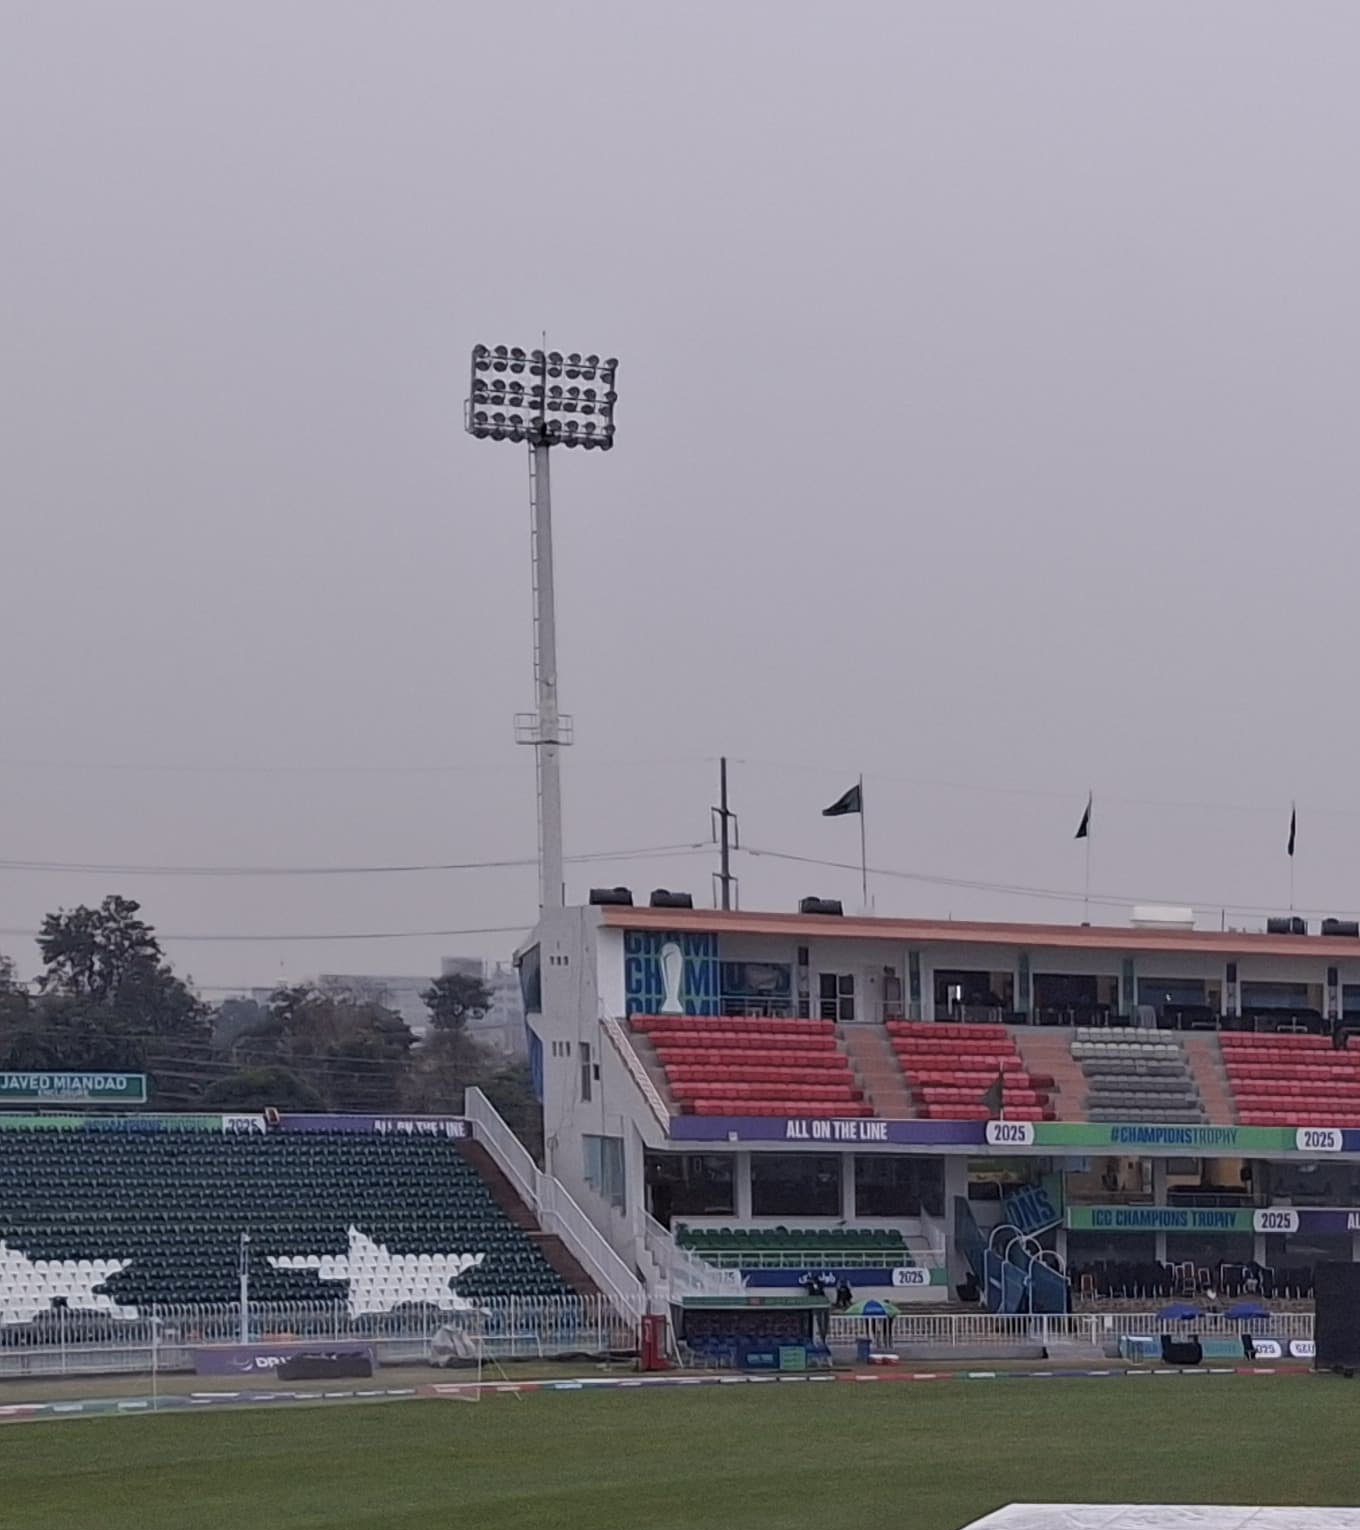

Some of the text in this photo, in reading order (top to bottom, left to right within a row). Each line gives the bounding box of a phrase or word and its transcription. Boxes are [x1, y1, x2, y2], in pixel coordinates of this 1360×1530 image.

[1, 1076, 127, 1090] JAVED MIANDAD
[786, 1119, 888, 1141] ALL ON THE LINE
[994, 1124, 1026, 1142] 2025
[1304, 1131, 1335, 1148] 2025
[1091, 1210, 1236, 1228] ICC CHAMPIONS TROPHY
[1261, 1213, 1291, 1229] 2025
[898, 1270, 924, 1284] 2025
